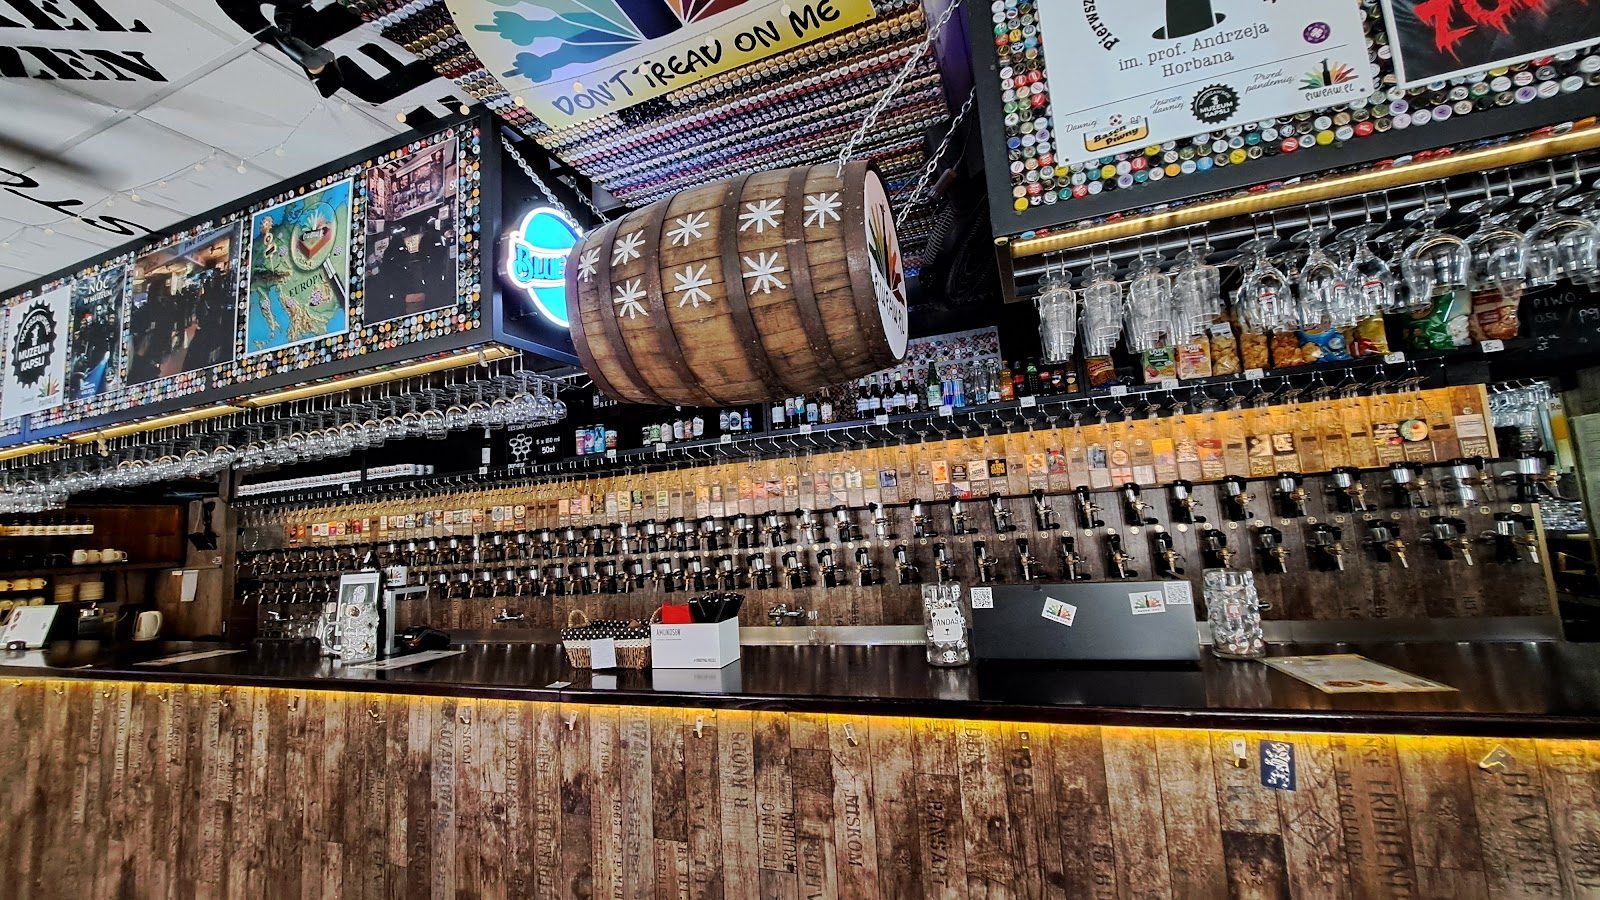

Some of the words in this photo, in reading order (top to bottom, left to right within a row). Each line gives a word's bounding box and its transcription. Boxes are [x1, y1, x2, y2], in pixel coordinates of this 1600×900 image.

[1119, 57, 1143, 71] im.
[1148, 43, 1186, 65] prof.
[1192, 22, 1269, 52] Andrzeja
[552, 70, 634, 116] DON'T
[632, 39, 722, 88] TREAD
[734, 20, 780, 53] ON
[788, 0, 840, 38] ME
[1162, 50, 1234, 77] Horbana
[1199, 101, 1233, 113] MUZEUM
[1204, 108, 1230, 118] KAPSLI
[289, 273, 324, 298] EUROPA
[18, 343, 50, 361] MUZEUM
[20, 355, 45, 371] KAPSLI
[933, 617, 959, 626] PANDAS
[731, 731, 748, 789] KNOPS
